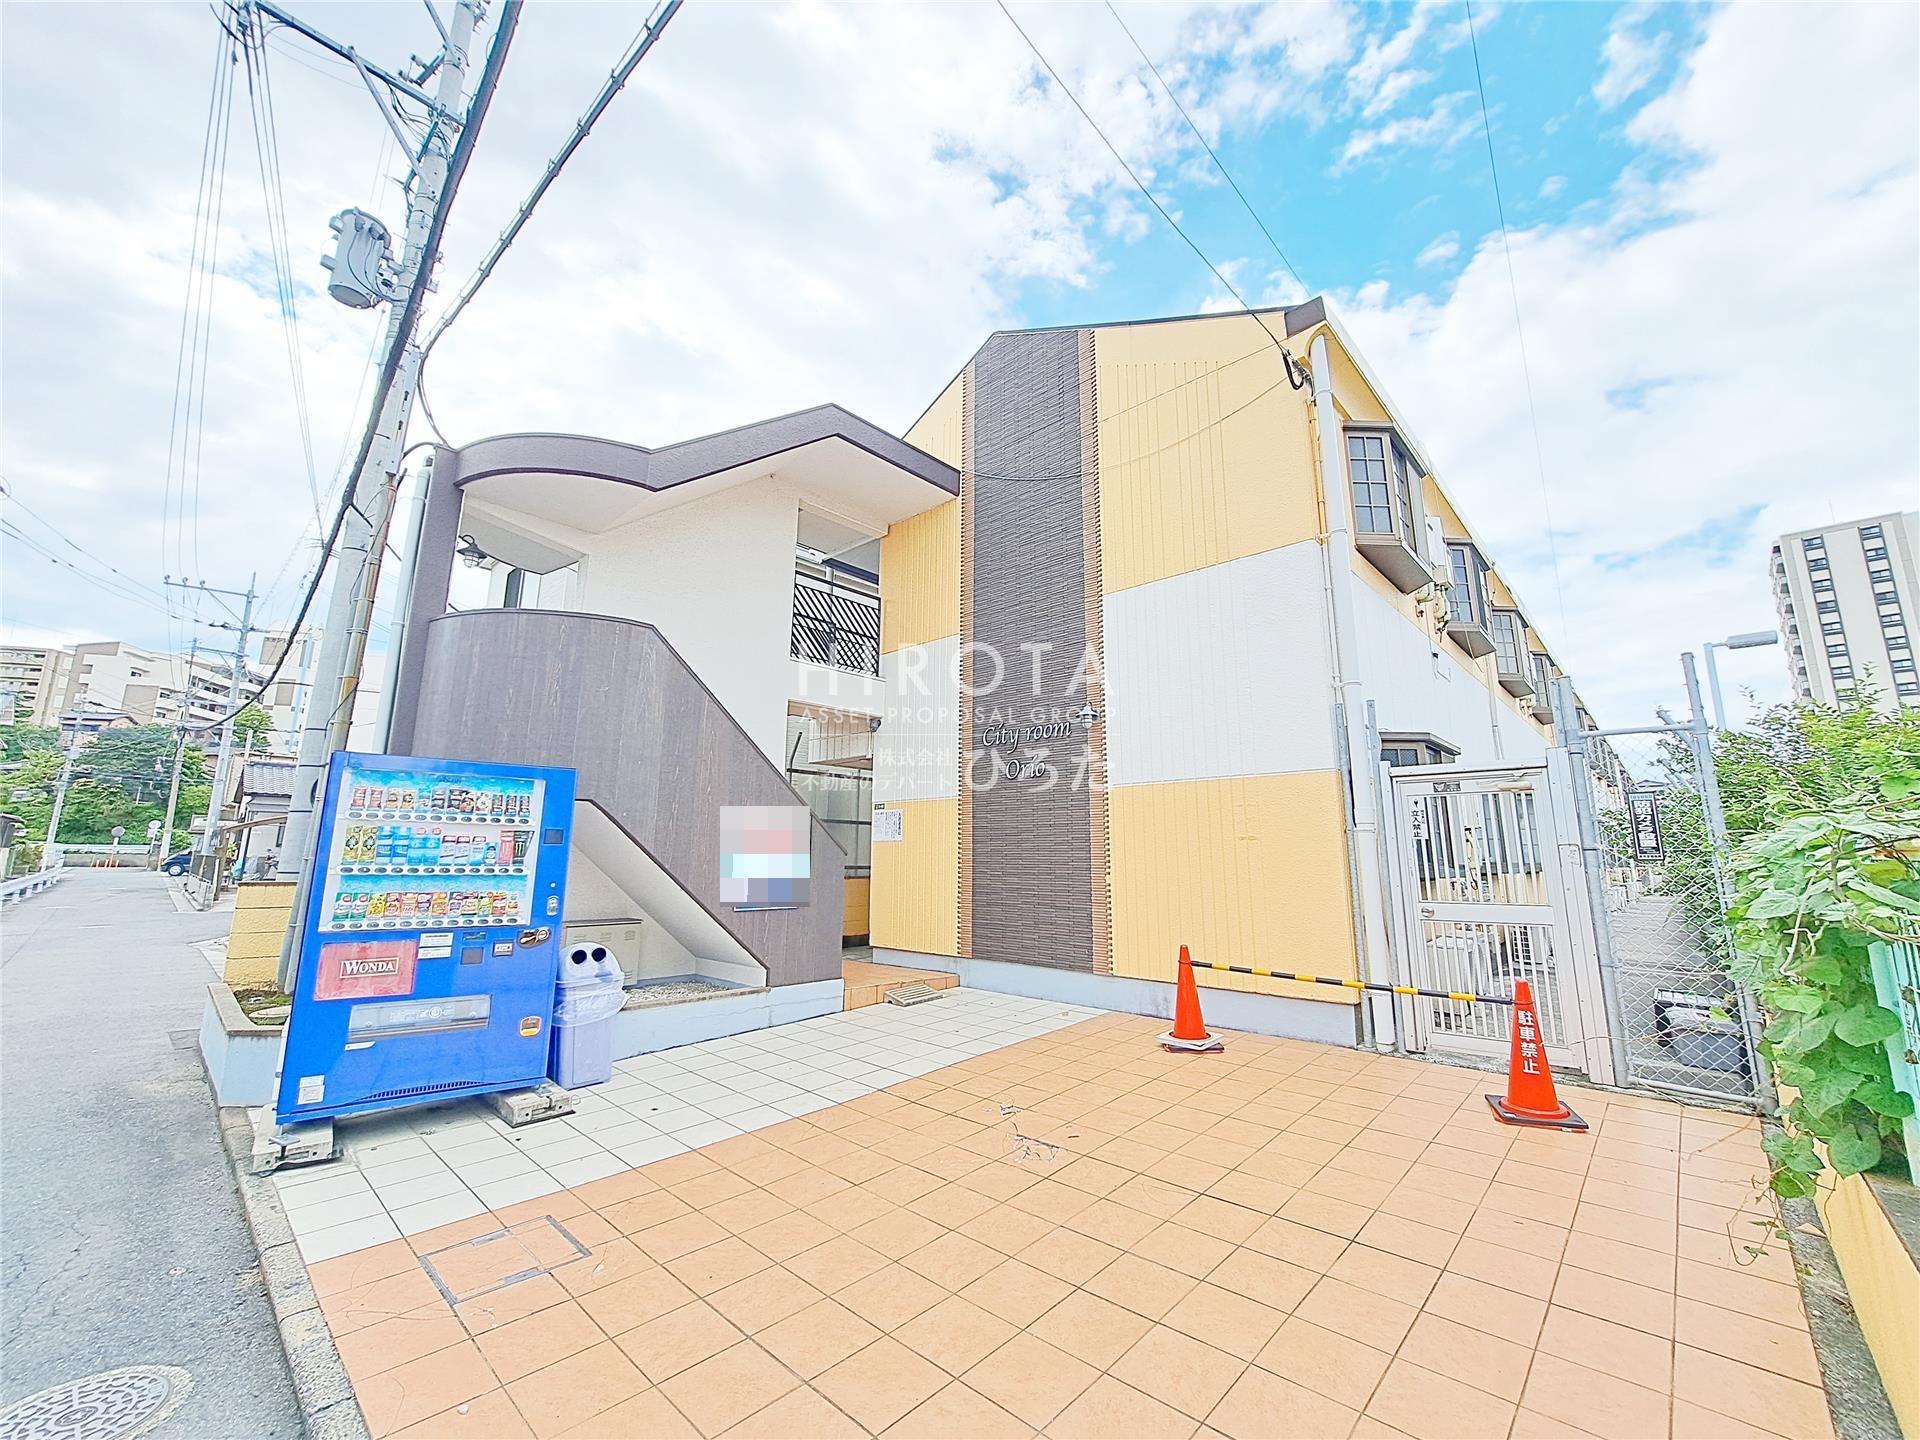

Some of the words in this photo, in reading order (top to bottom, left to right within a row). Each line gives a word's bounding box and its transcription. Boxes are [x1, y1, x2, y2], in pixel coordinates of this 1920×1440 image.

[982, 721, 1020, 754] City
[1026, 721, 1072, 741] room
[1005, 755, 1046, 780] Orio
[1410, 809, 1423, 838] 立入禁止
[344, 960, 394, 975] WONDA
[1517, 1010, 1541, 1075] 駐車禁止
